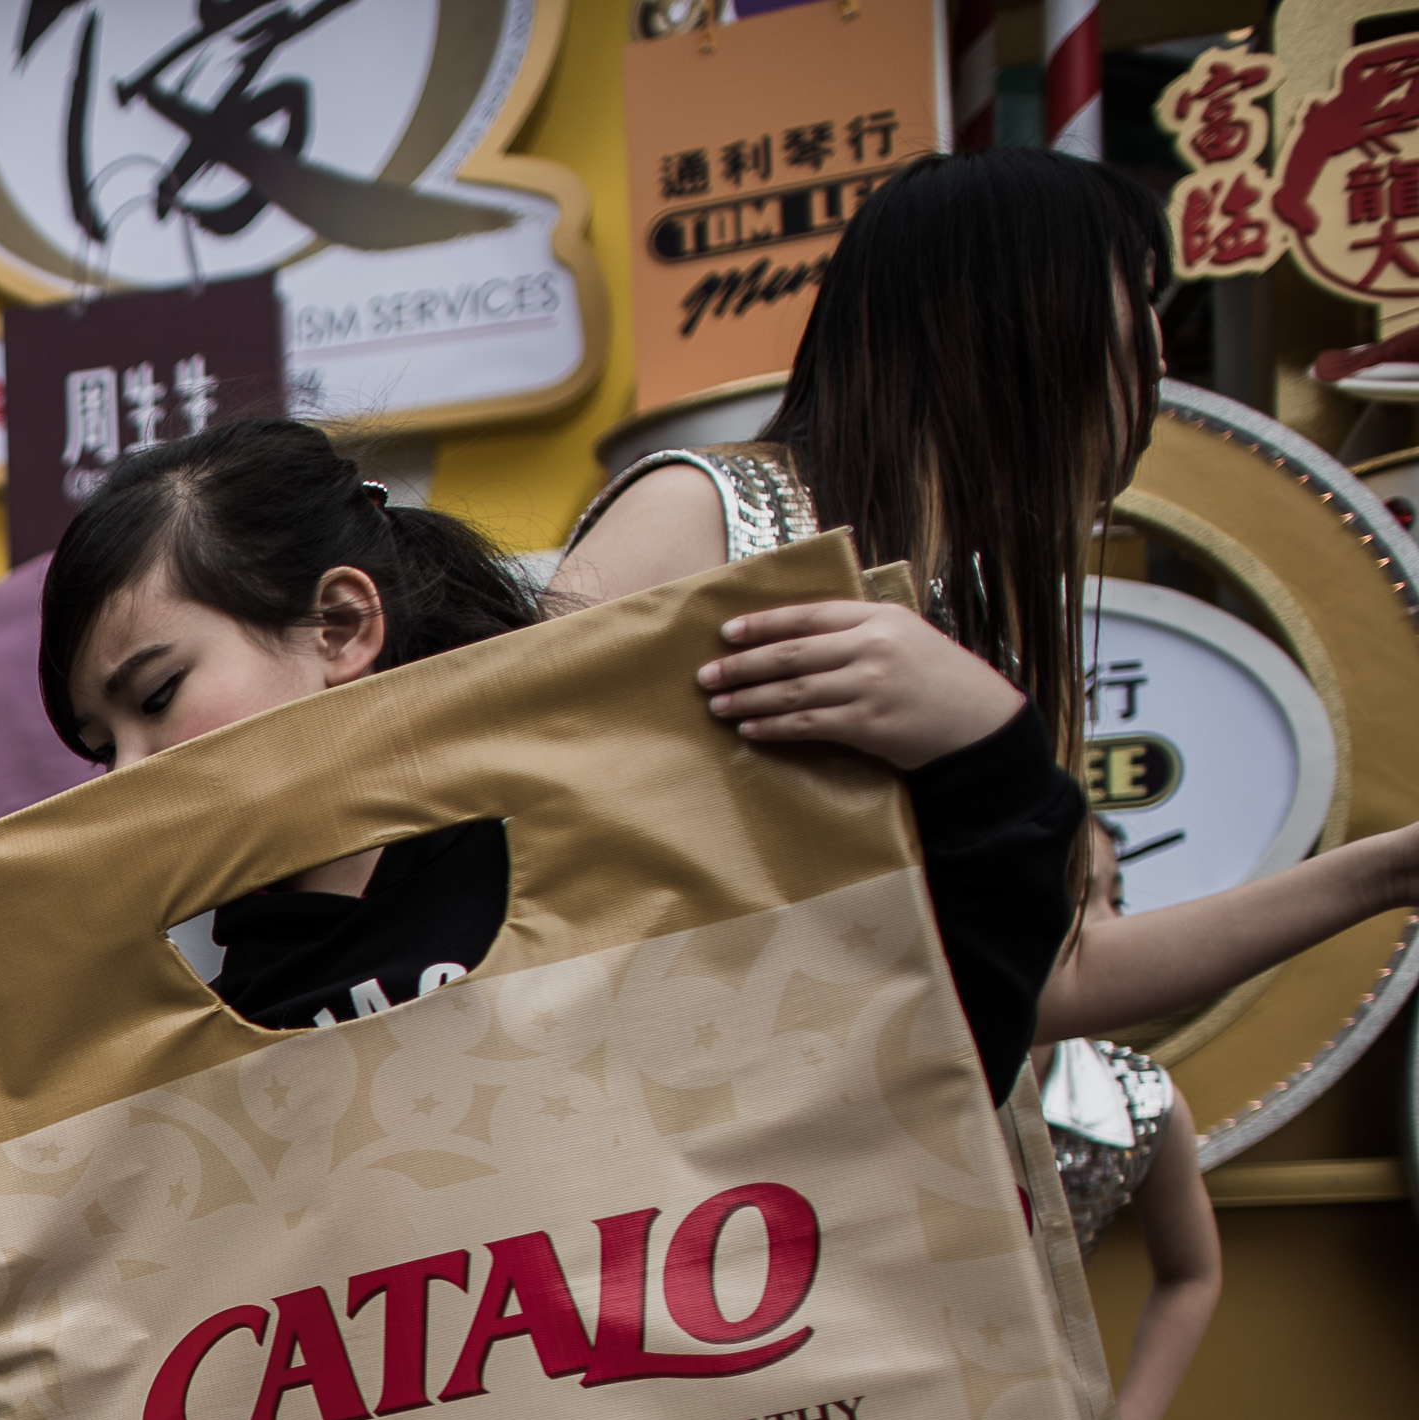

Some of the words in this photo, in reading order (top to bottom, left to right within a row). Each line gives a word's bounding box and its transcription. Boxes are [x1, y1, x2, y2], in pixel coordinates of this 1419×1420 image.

[660, 110, 897, 198] 通利琴行
[1174, 62, 1270, 268] 富臨
[671, 194, 781, 256] TOM
[369, 270, 560, 337] SERVICES
[61, 353, 216, 466] 周生生
